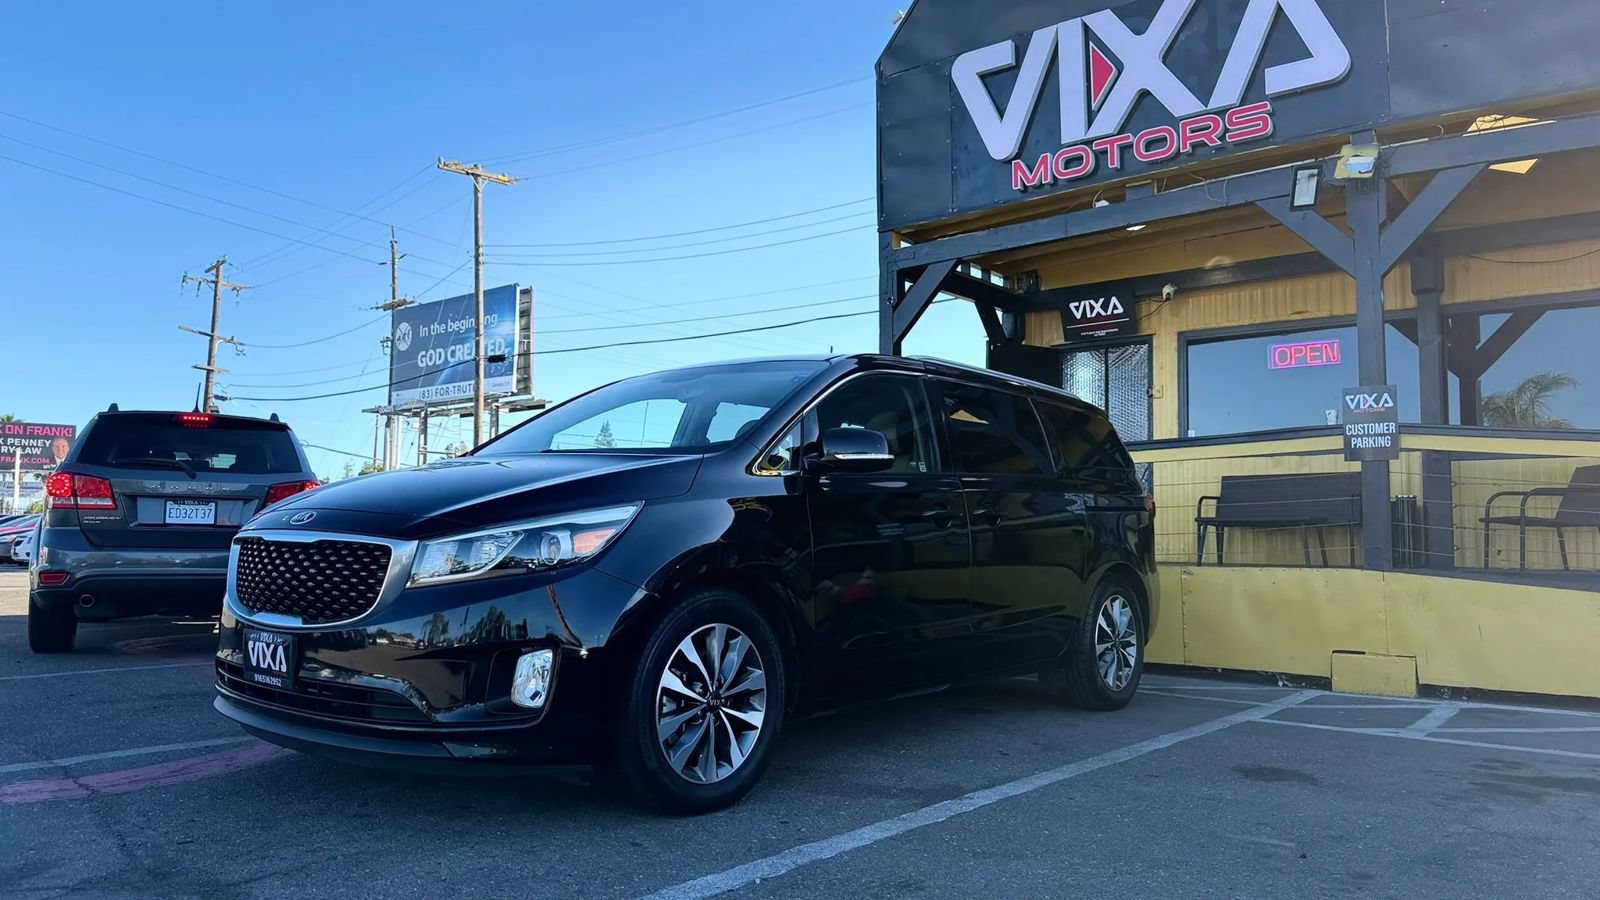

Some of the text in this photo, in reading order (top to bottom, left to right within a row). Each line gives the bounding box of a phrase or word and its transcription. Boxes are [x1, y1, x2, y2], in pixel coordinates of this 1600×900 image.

[951, 0, 1351, 161] VIXA
[1011, 101, 1273, 191] MOTORS
[1069, 296, 1124, 320] VIXA
[420, 325, 429, 337] In
[430, 321, 446, 334] the
[447, 313, 498, 333] beginng
[417, 348, 445, 368] GOD
[1275, 342, 1338, 366] OPEN
[435, 383, 475, 397] FOR-TRUT
[1345, 393, 1394, 410] VIXA
[5, 425, 23, 435] ON
[27, 426, 72, 437] FRANK!
[1346, 422, 1396, 435] CUSTOMER
[7, 438, 51, 447] PENNEY
[1351, 435, 1391, 449] PARKING
[168, 507, 213, 519] ED32T37
[248, 640, 287, 672] VIXA
